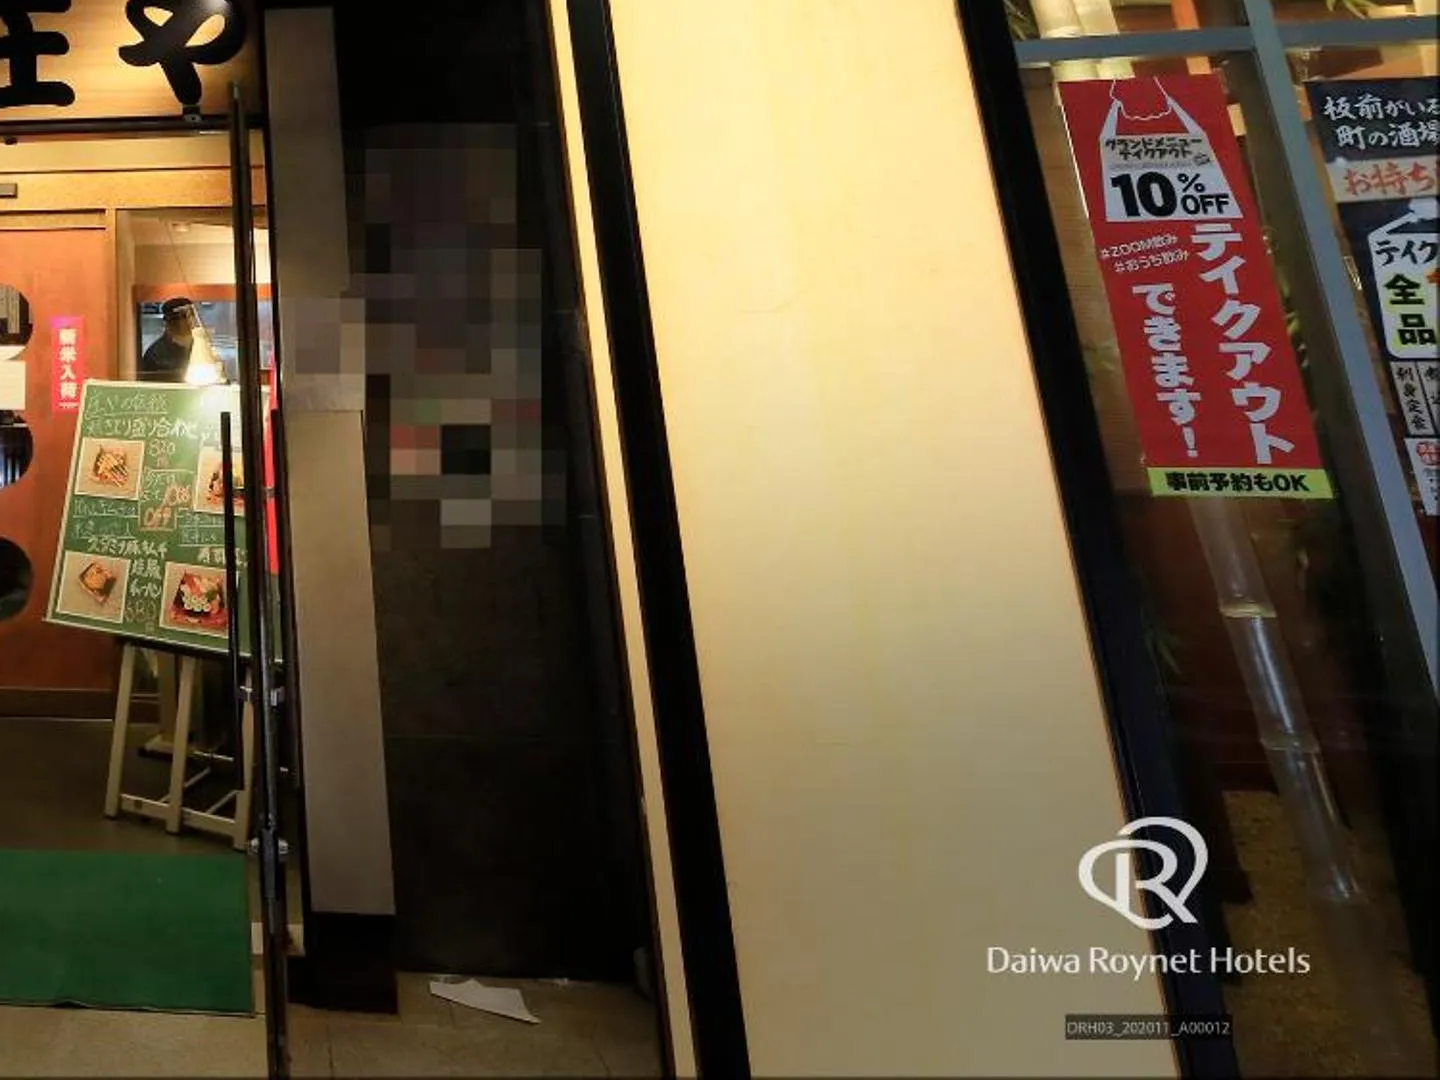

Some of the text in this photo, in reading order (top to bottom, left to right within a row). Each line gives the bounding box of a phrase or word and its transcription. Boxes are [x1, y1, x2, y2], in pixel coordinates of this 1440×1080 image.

[1191, 223, 1295, 464] テイクアウト
[1383, 273, 1436, 345] 全品
[1166, 472, 1309, 492] 事前予約もOK
